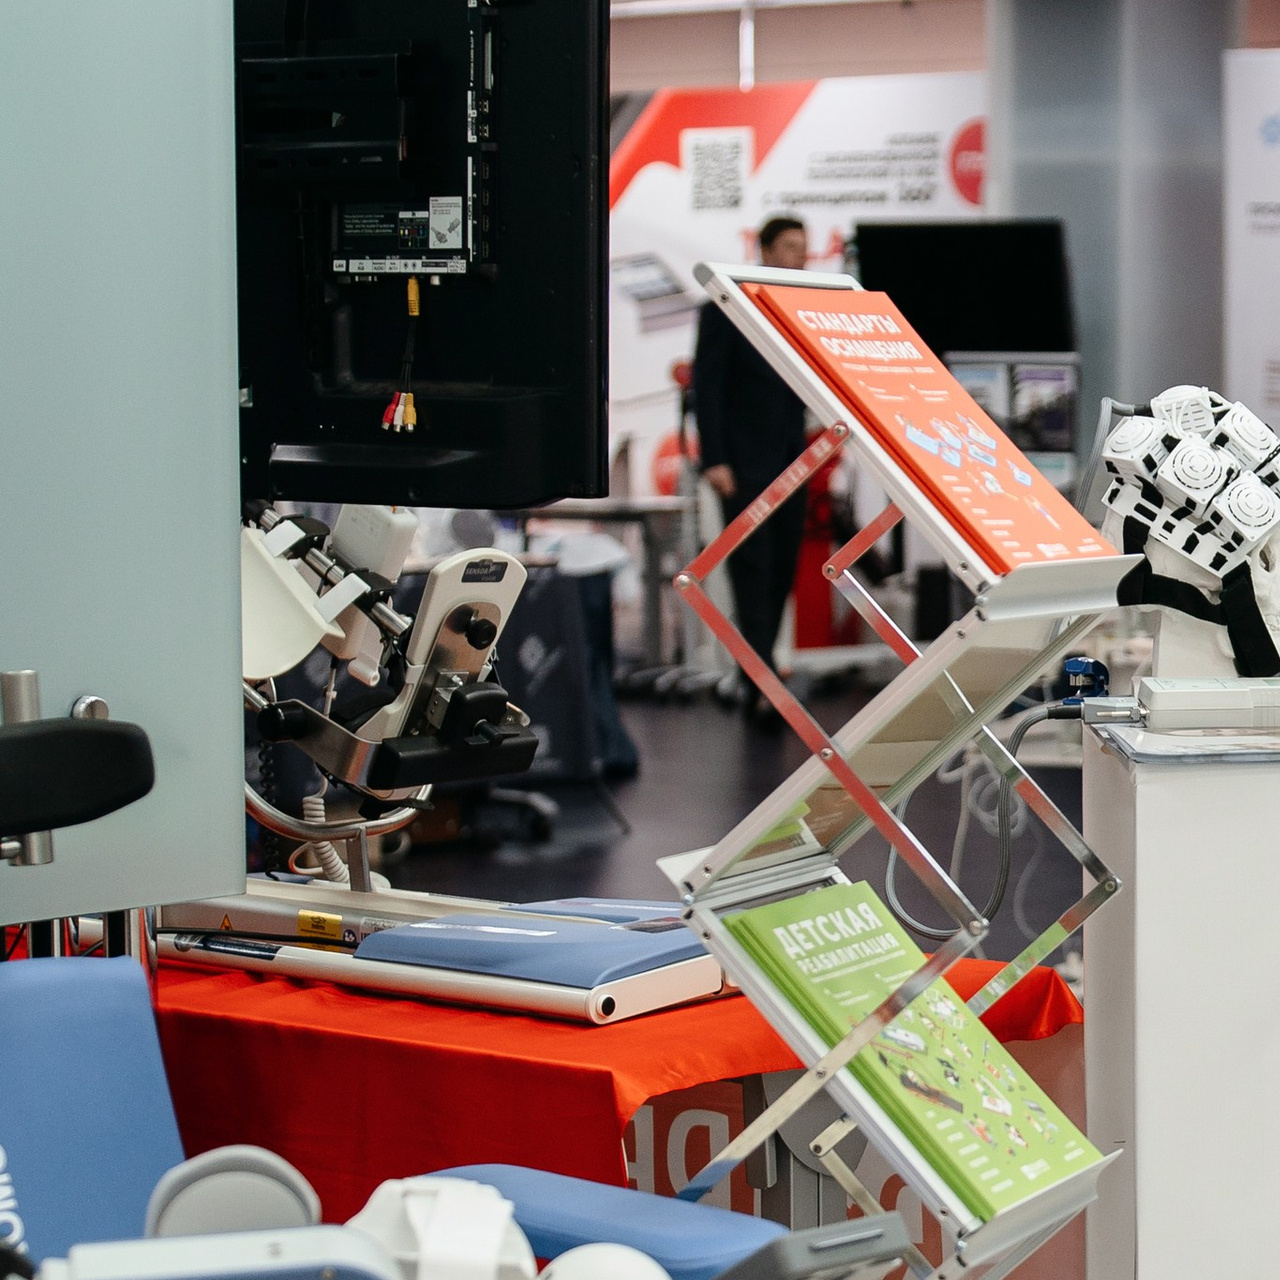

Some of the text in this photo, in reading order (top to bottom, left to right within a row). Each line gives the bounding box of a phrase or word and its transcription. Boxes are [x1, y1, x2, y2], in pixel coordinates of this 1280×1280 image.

[796, 309, 902, 335] СТАНДАРТЫ
[819, 335, 923, 361] ОСНАЩЕНИЯ
[773, 901, 884, 959] ДЕТСКАЯ
[795, 931, 900, 976] РЕАБИЛИТАЦИЯ
